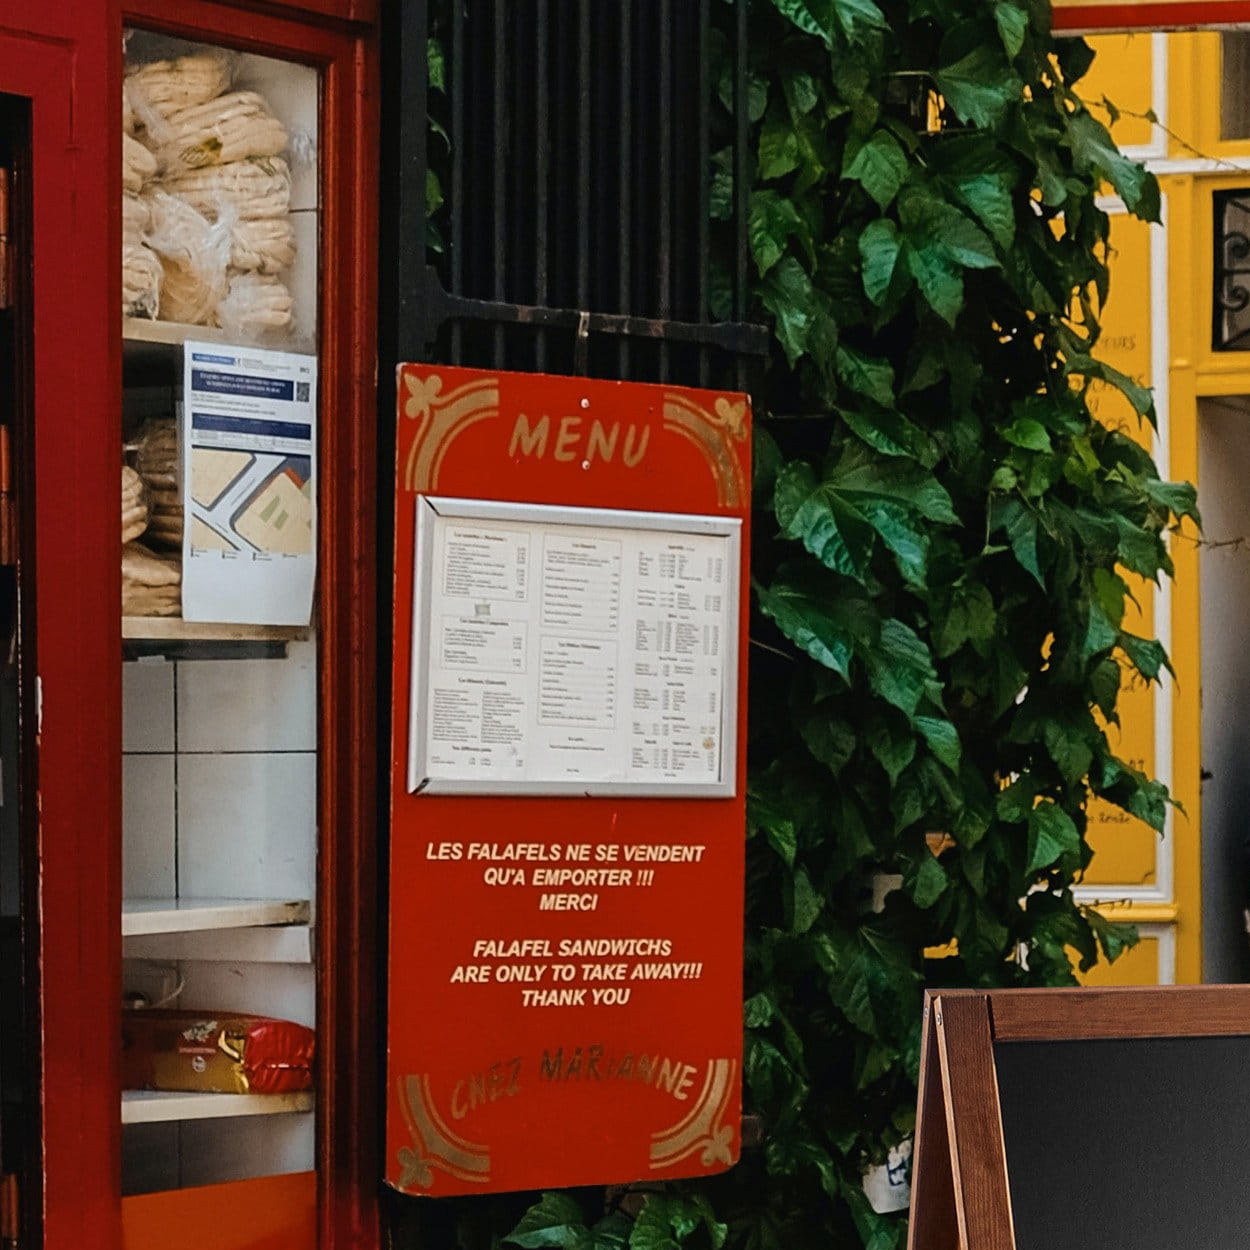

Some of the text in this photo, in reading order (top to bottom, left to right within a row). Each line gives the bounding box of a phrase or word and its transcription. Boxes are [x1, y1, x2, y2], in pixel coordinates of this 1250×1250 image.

[508, 414, 651, 468] MENU
[426, 842, 705, 862] LES FALAFELS NE SE VENDENT
[484, 868, 525, 886] QU'A
[532, 869, 631, 886] EMPORTER
[539, 894, 598, 911] MERCI
[473, 939, 673, 957] FALAFEL SANDWICHS
[450, 963, 702, 982] ARE ONLY TO TAKE AWAY!!!
[522, 988, 630, 1006] THANK YOU
[450, 1057, 524, 1120] CHEZ
